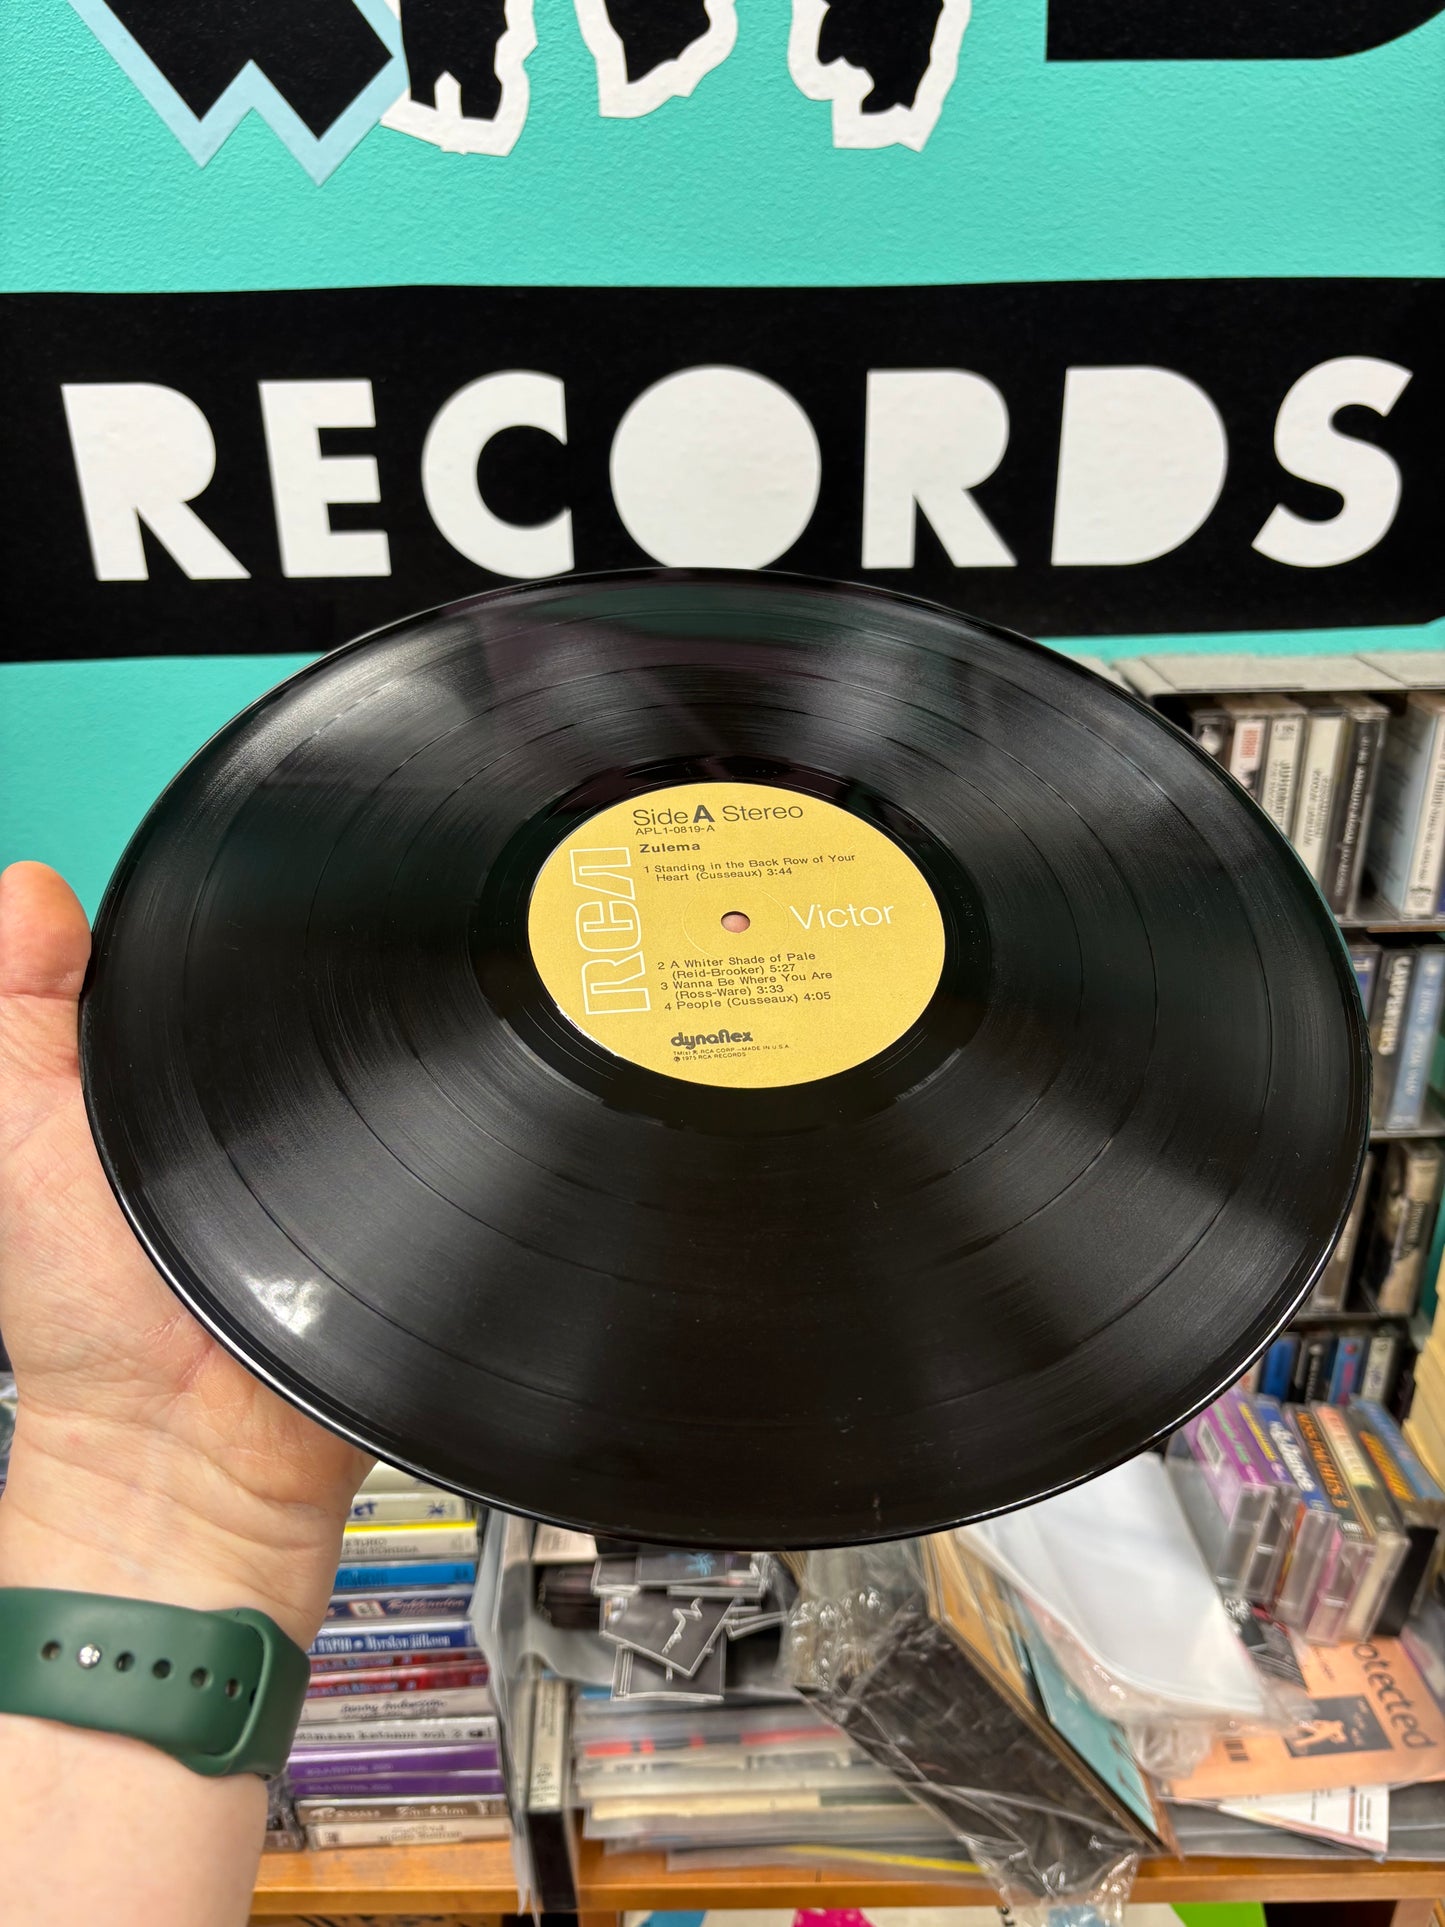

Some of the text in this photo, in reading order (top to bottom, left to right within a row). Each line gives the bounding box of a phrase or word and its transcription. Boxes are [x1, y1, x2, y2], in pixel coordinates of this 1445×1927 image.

[61, 356, 1413, 580] RECORDS
[633, 804, 804, 827] Side A Stereo
[635, 824, 716, 836] APL1-0819-A
[639, 842, 701, 854] Zulema
[655, 863, 706, 874] Standing
[710, 861, 722, 870] in
[725, 860, 745, 869] the
[749, 858, 779, 868] Back
[783, 856, 809, 866] Row
[812, 854, 824, 864] of
[828, 853, 856, 863] Your
[656, 867, 793, 882] Heart (Cusseaux) 3:44
[789, 901, 896, 931] Victor
[569, 846, 652, 1017] RCA
[657, 951, 817, 970] 2 A Whiter Shade of Pale
[660, 970, 833, 991] 3 Wanna Be Where You Are
[672, 963, 796, 981] (Reid-Brooker) 5:27
[664, 991, 832, 1011] 4 People (Cusseaux) 4:05
[675, 984, 785, 1001] (Ross-Ware) 3:33
[670, 1028, 754, 1050] dynaflex
[714, 1052, 747, 1060] RECORDS
[1353, 1642, 1438, 1749] otected
